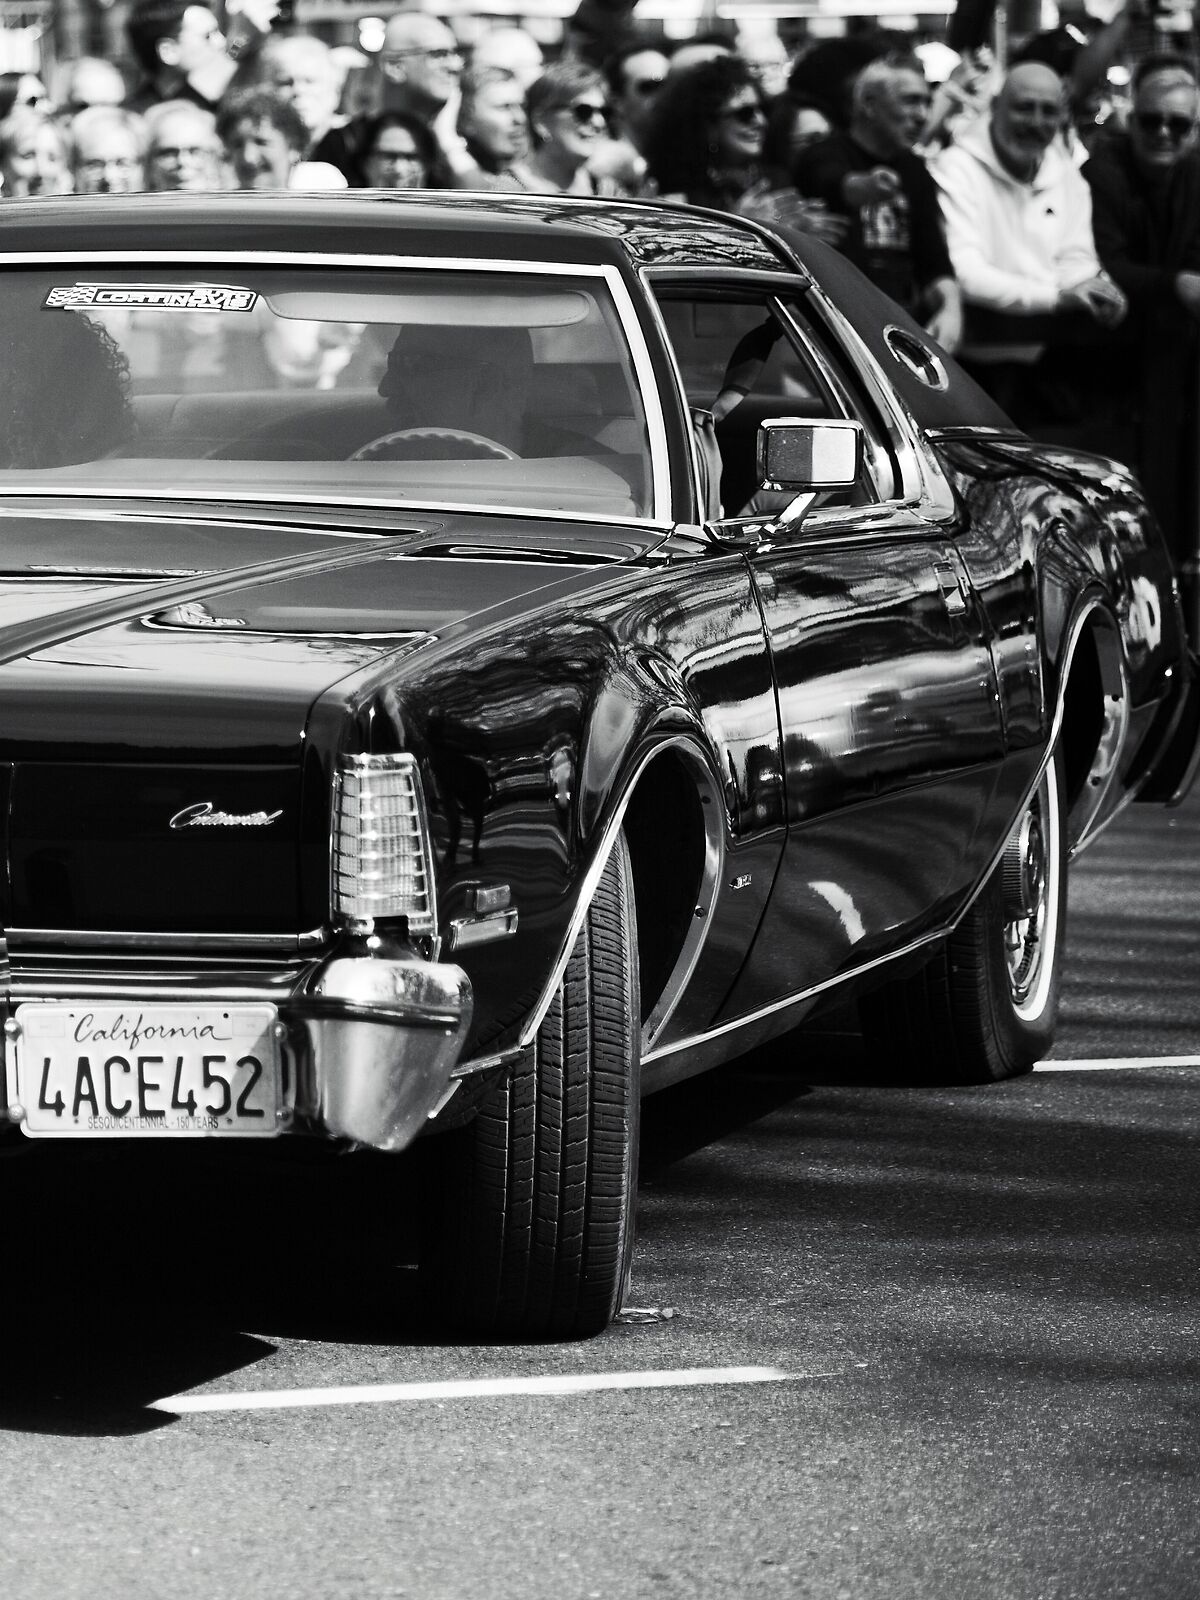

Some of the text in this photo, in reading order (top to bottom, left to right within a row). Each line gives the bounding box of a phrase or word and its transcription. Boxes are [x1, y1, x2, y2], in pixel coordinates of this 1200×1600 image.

[73, 1013, 233, 1050] California
[38, 1055, 265, 1117] 4ACE452
[87, 1116, 169, 1129] SESQUICENTENNIAL
[176, 1117, 190, 1129] 150
[192, 1117, 219, 1129] YEARS
